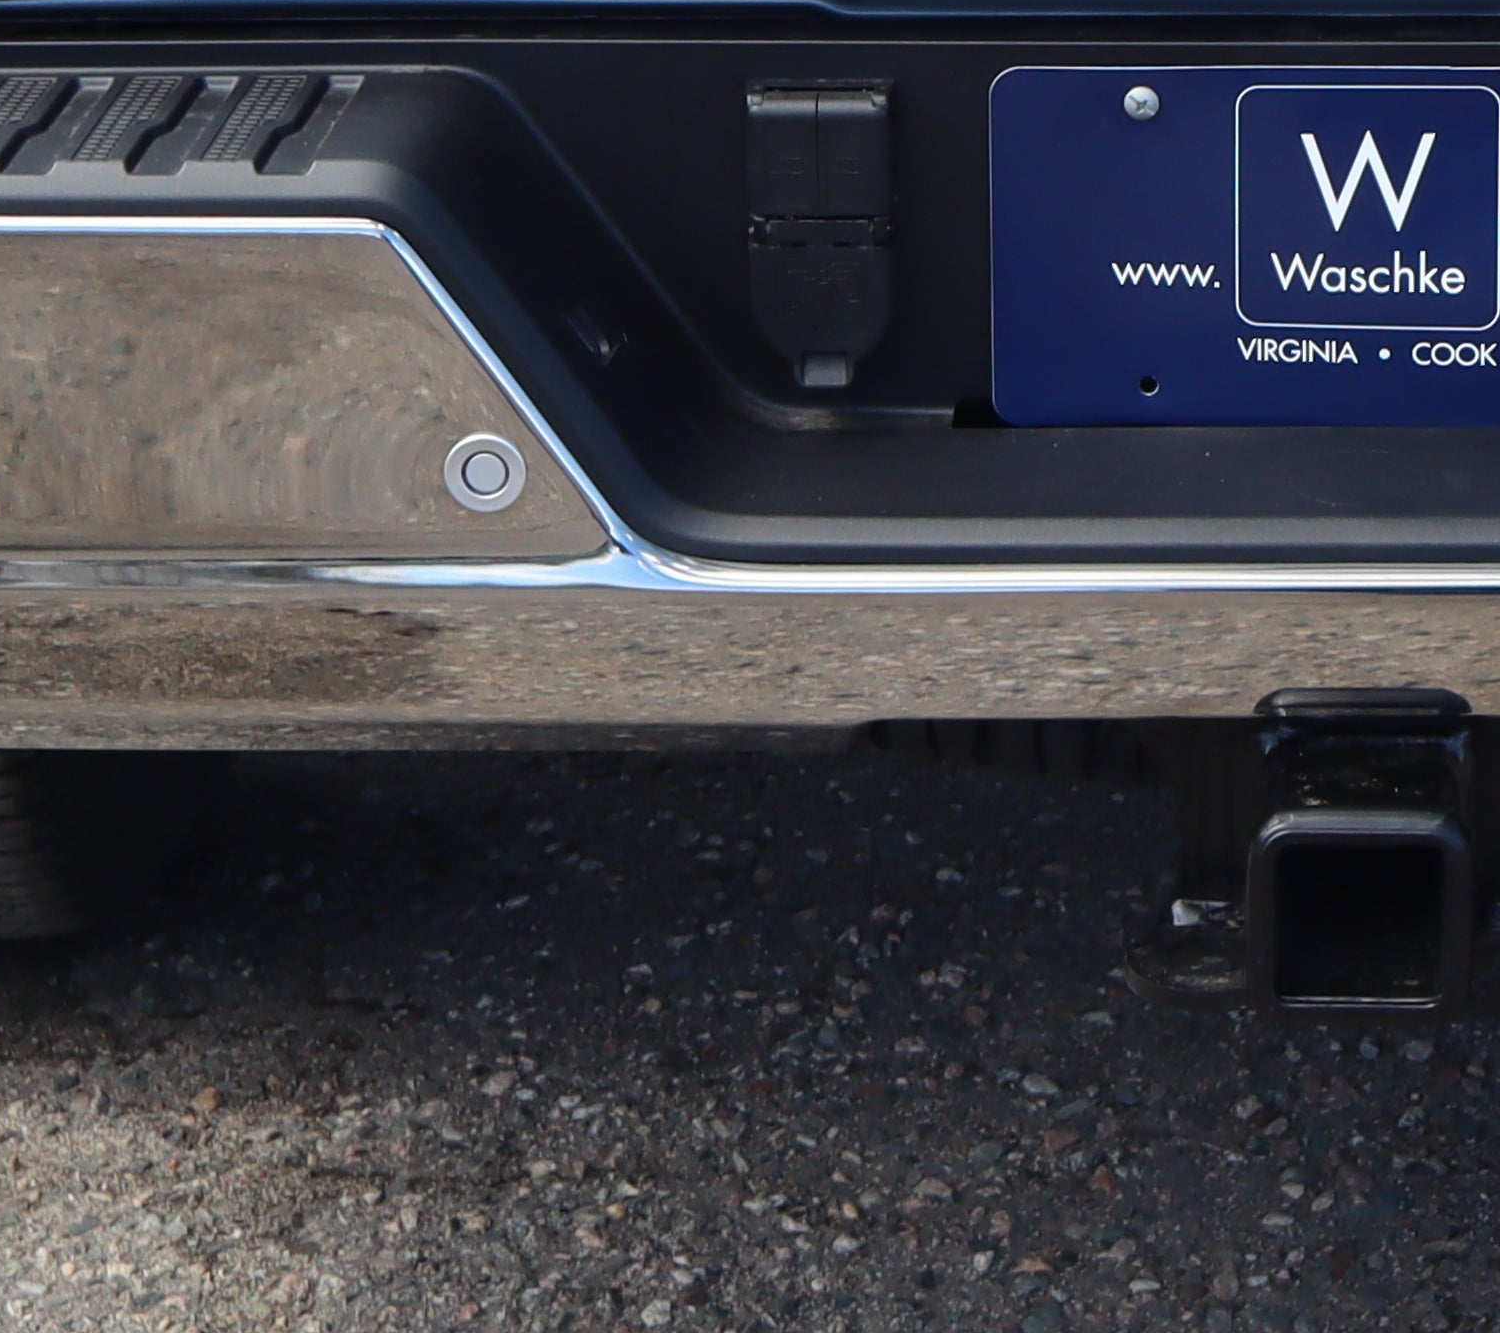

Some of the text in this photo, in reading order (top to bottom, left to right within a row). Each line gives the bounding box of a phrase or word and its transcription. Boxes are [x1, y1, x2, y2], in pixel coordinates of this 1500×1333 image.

[1301, 130, 1436, 231] W
[1112, 262, 1221, 289] www.
[1271, 251, 1466, 295] Waschke
[1237, 337, 1498, 367] VIRGINIA COOK
